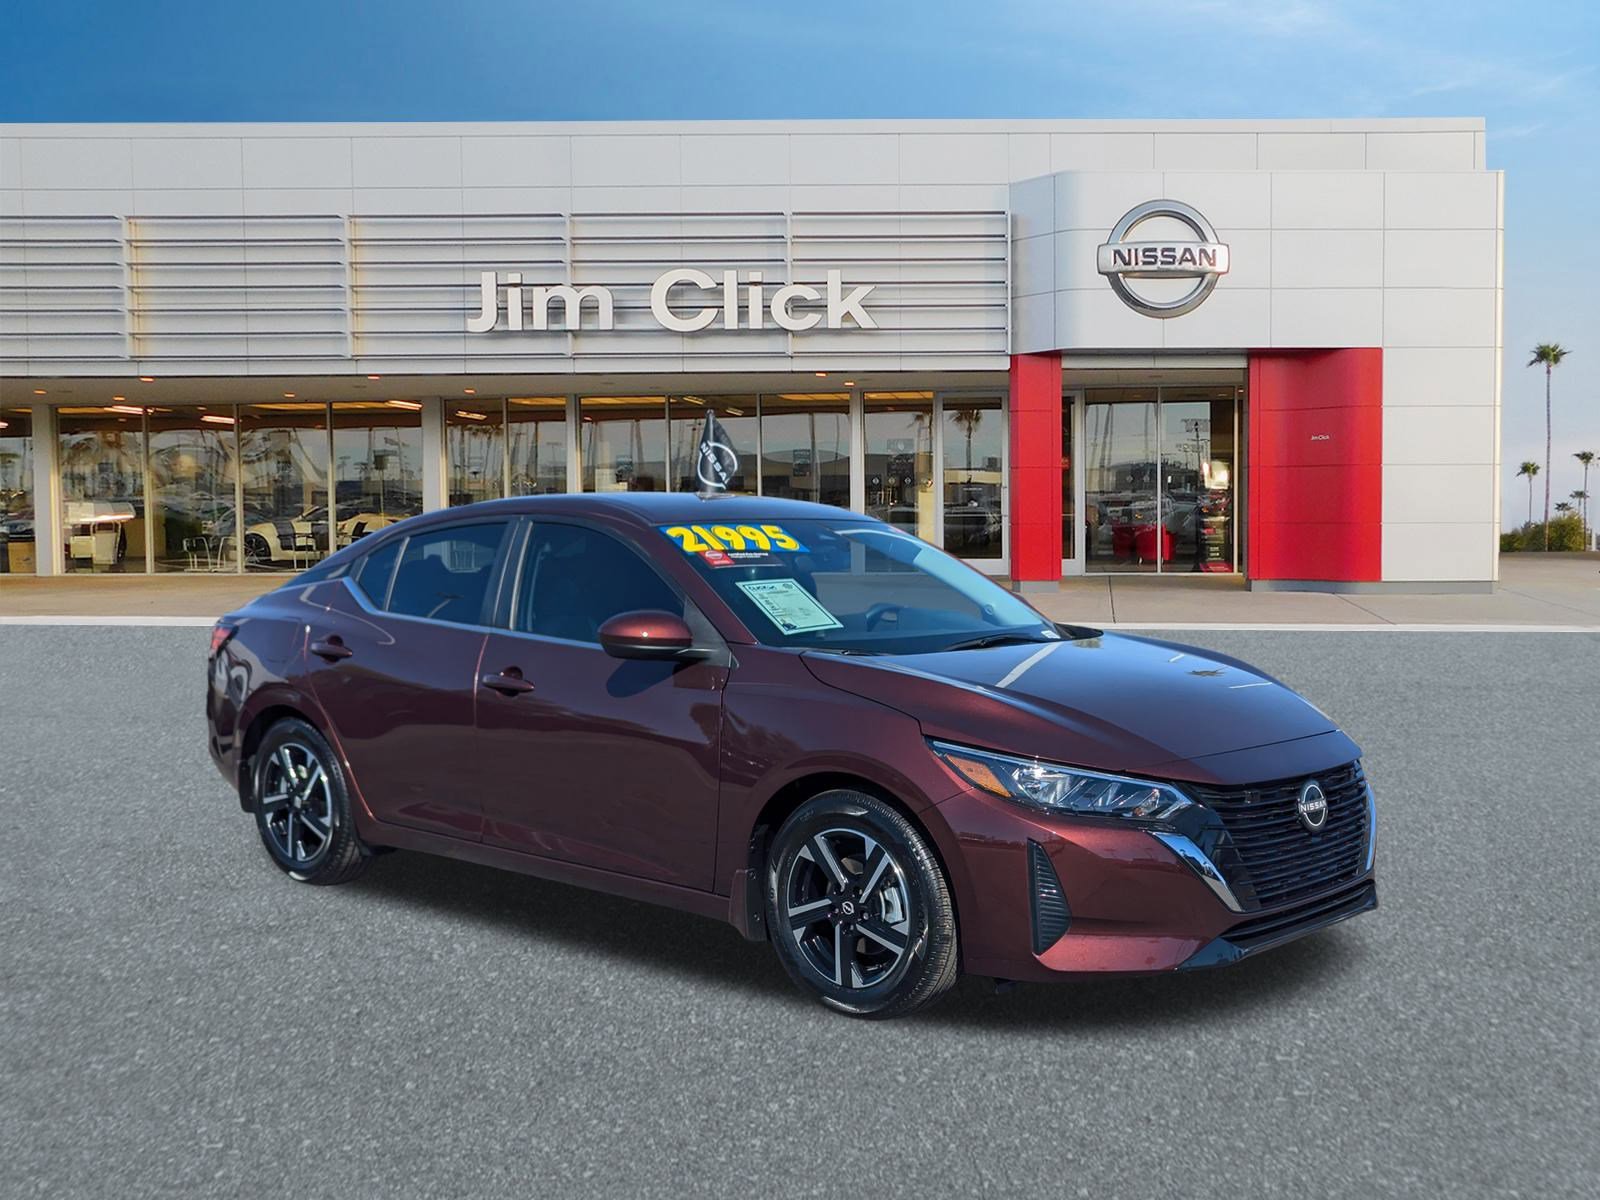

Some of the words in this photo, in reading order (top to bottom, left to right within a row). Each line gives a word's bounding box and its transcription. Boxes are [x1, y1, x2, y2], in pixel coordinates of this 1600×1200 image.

[1112, 247, 1217, 267] NISSAN
[467, 271, 615, 333] Jim
[650, 268, 880, 332] Click
[665, 524, 800, 553] 21995
[1300, 799, 1327, 812] NISSAN
